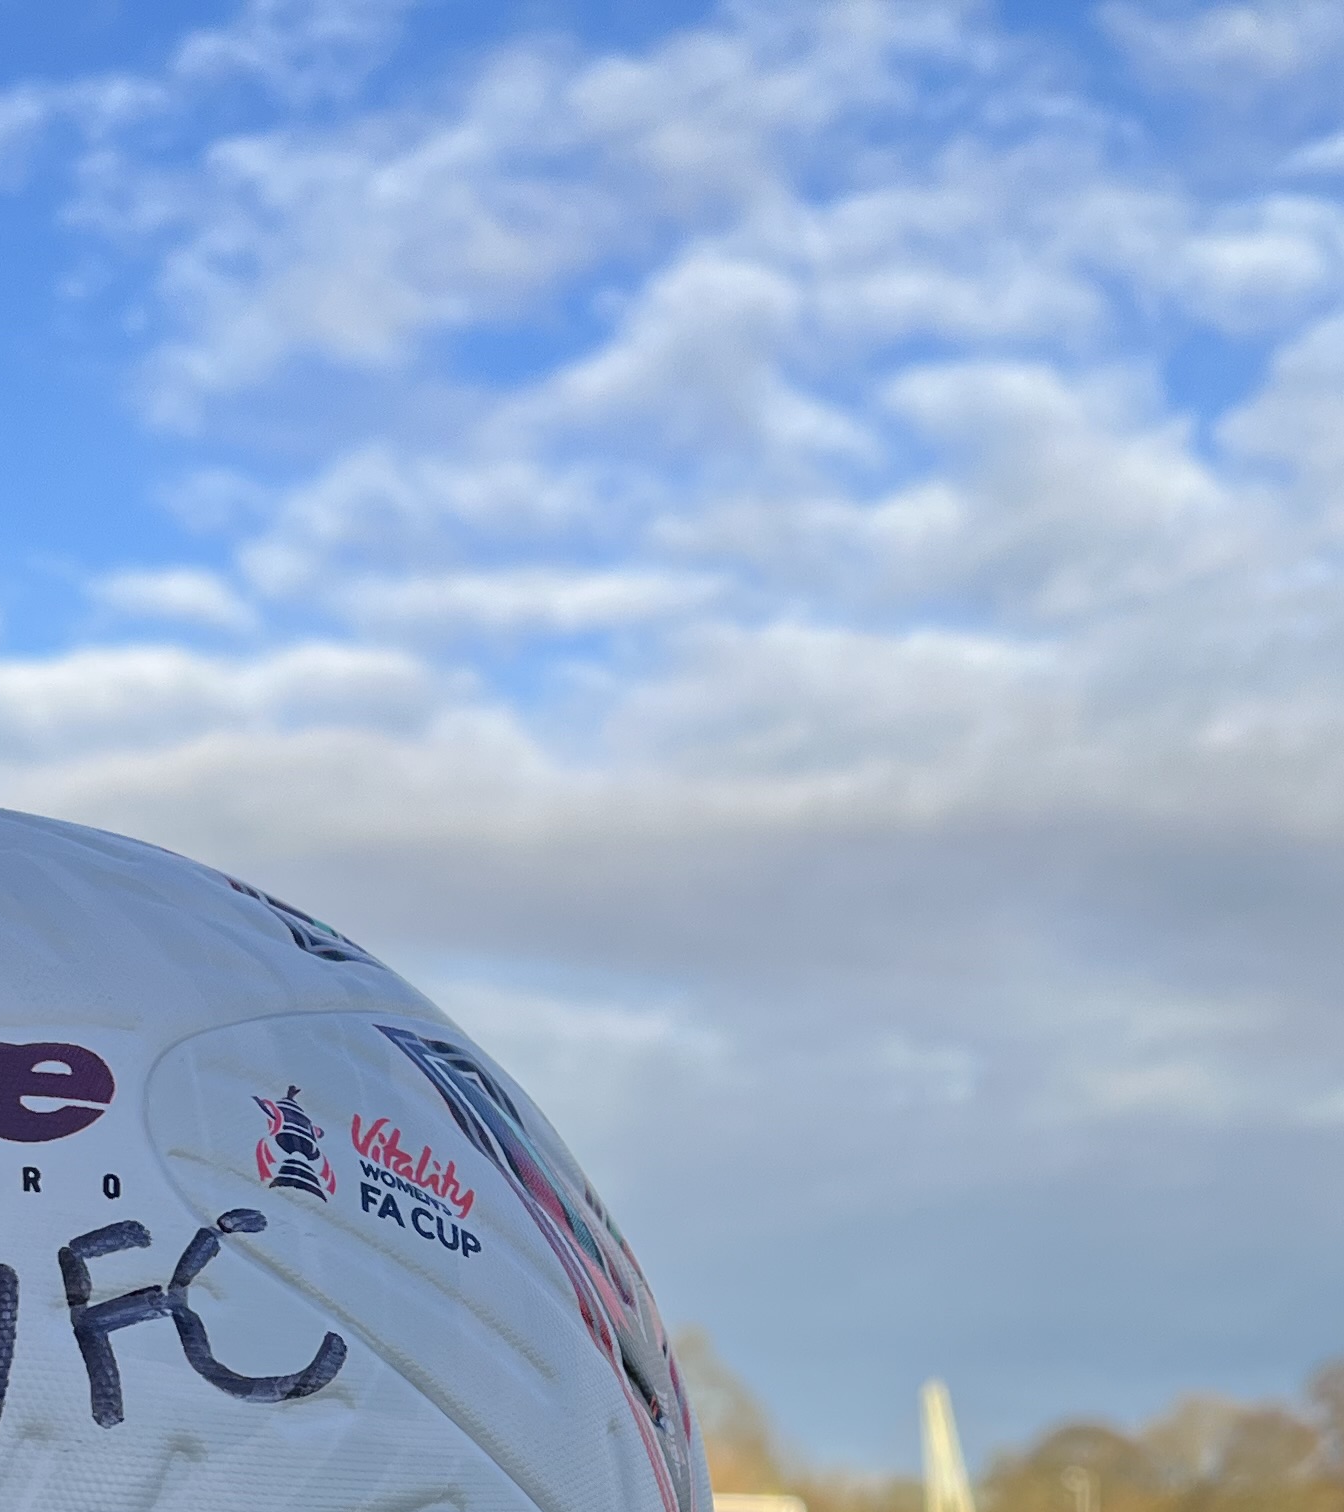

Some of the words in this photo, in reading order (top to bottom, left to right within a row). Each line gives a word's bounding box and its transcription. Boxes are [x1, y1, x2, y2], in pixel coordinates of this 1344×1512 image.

[351, 1114, 474, 1219] Vitality
[360, 1182, 406, 1228] FA
[411, 1207, 482, 1259] CUP
